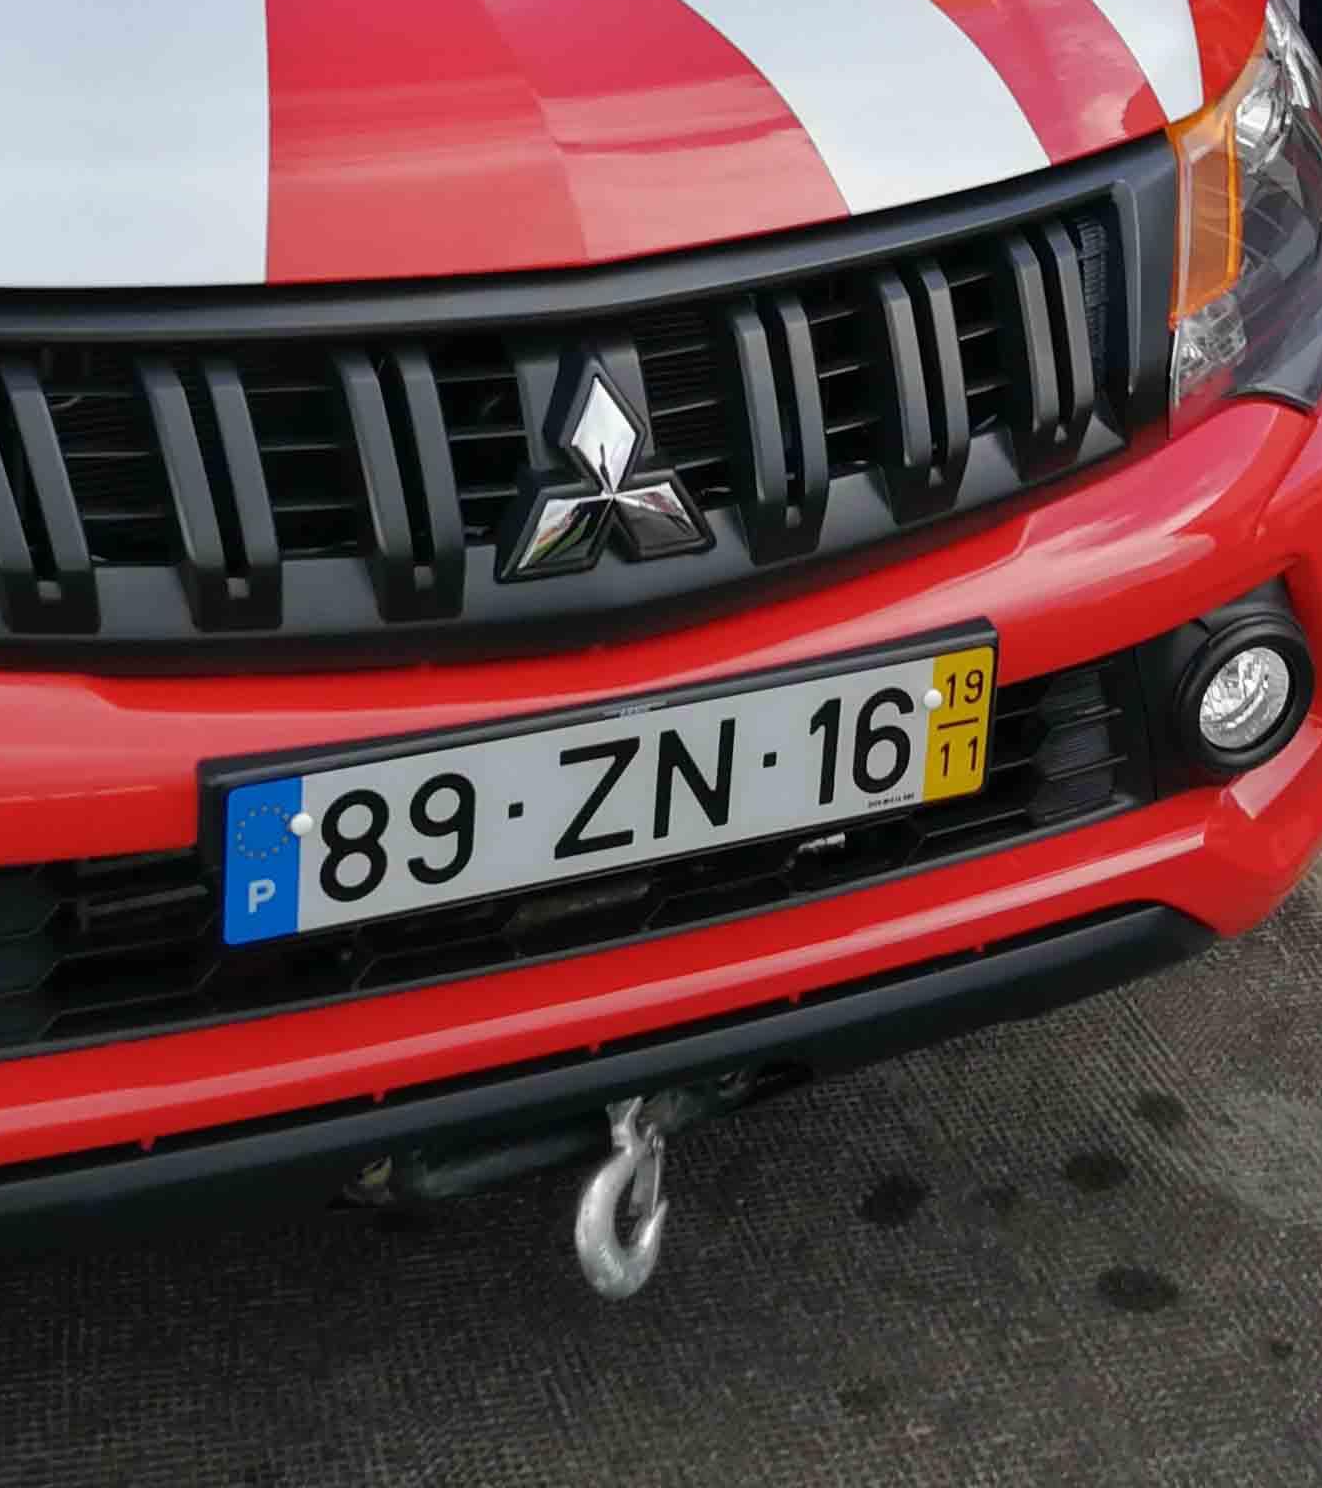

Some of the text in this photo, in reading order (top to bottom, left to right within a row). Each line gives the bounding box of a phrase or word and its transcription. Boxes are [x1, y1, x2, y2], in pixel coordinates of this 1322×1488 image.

[945, 668, 984, 709] 19
[938, 734, 979, 778] 11
[246, 878, 277, 914] P
